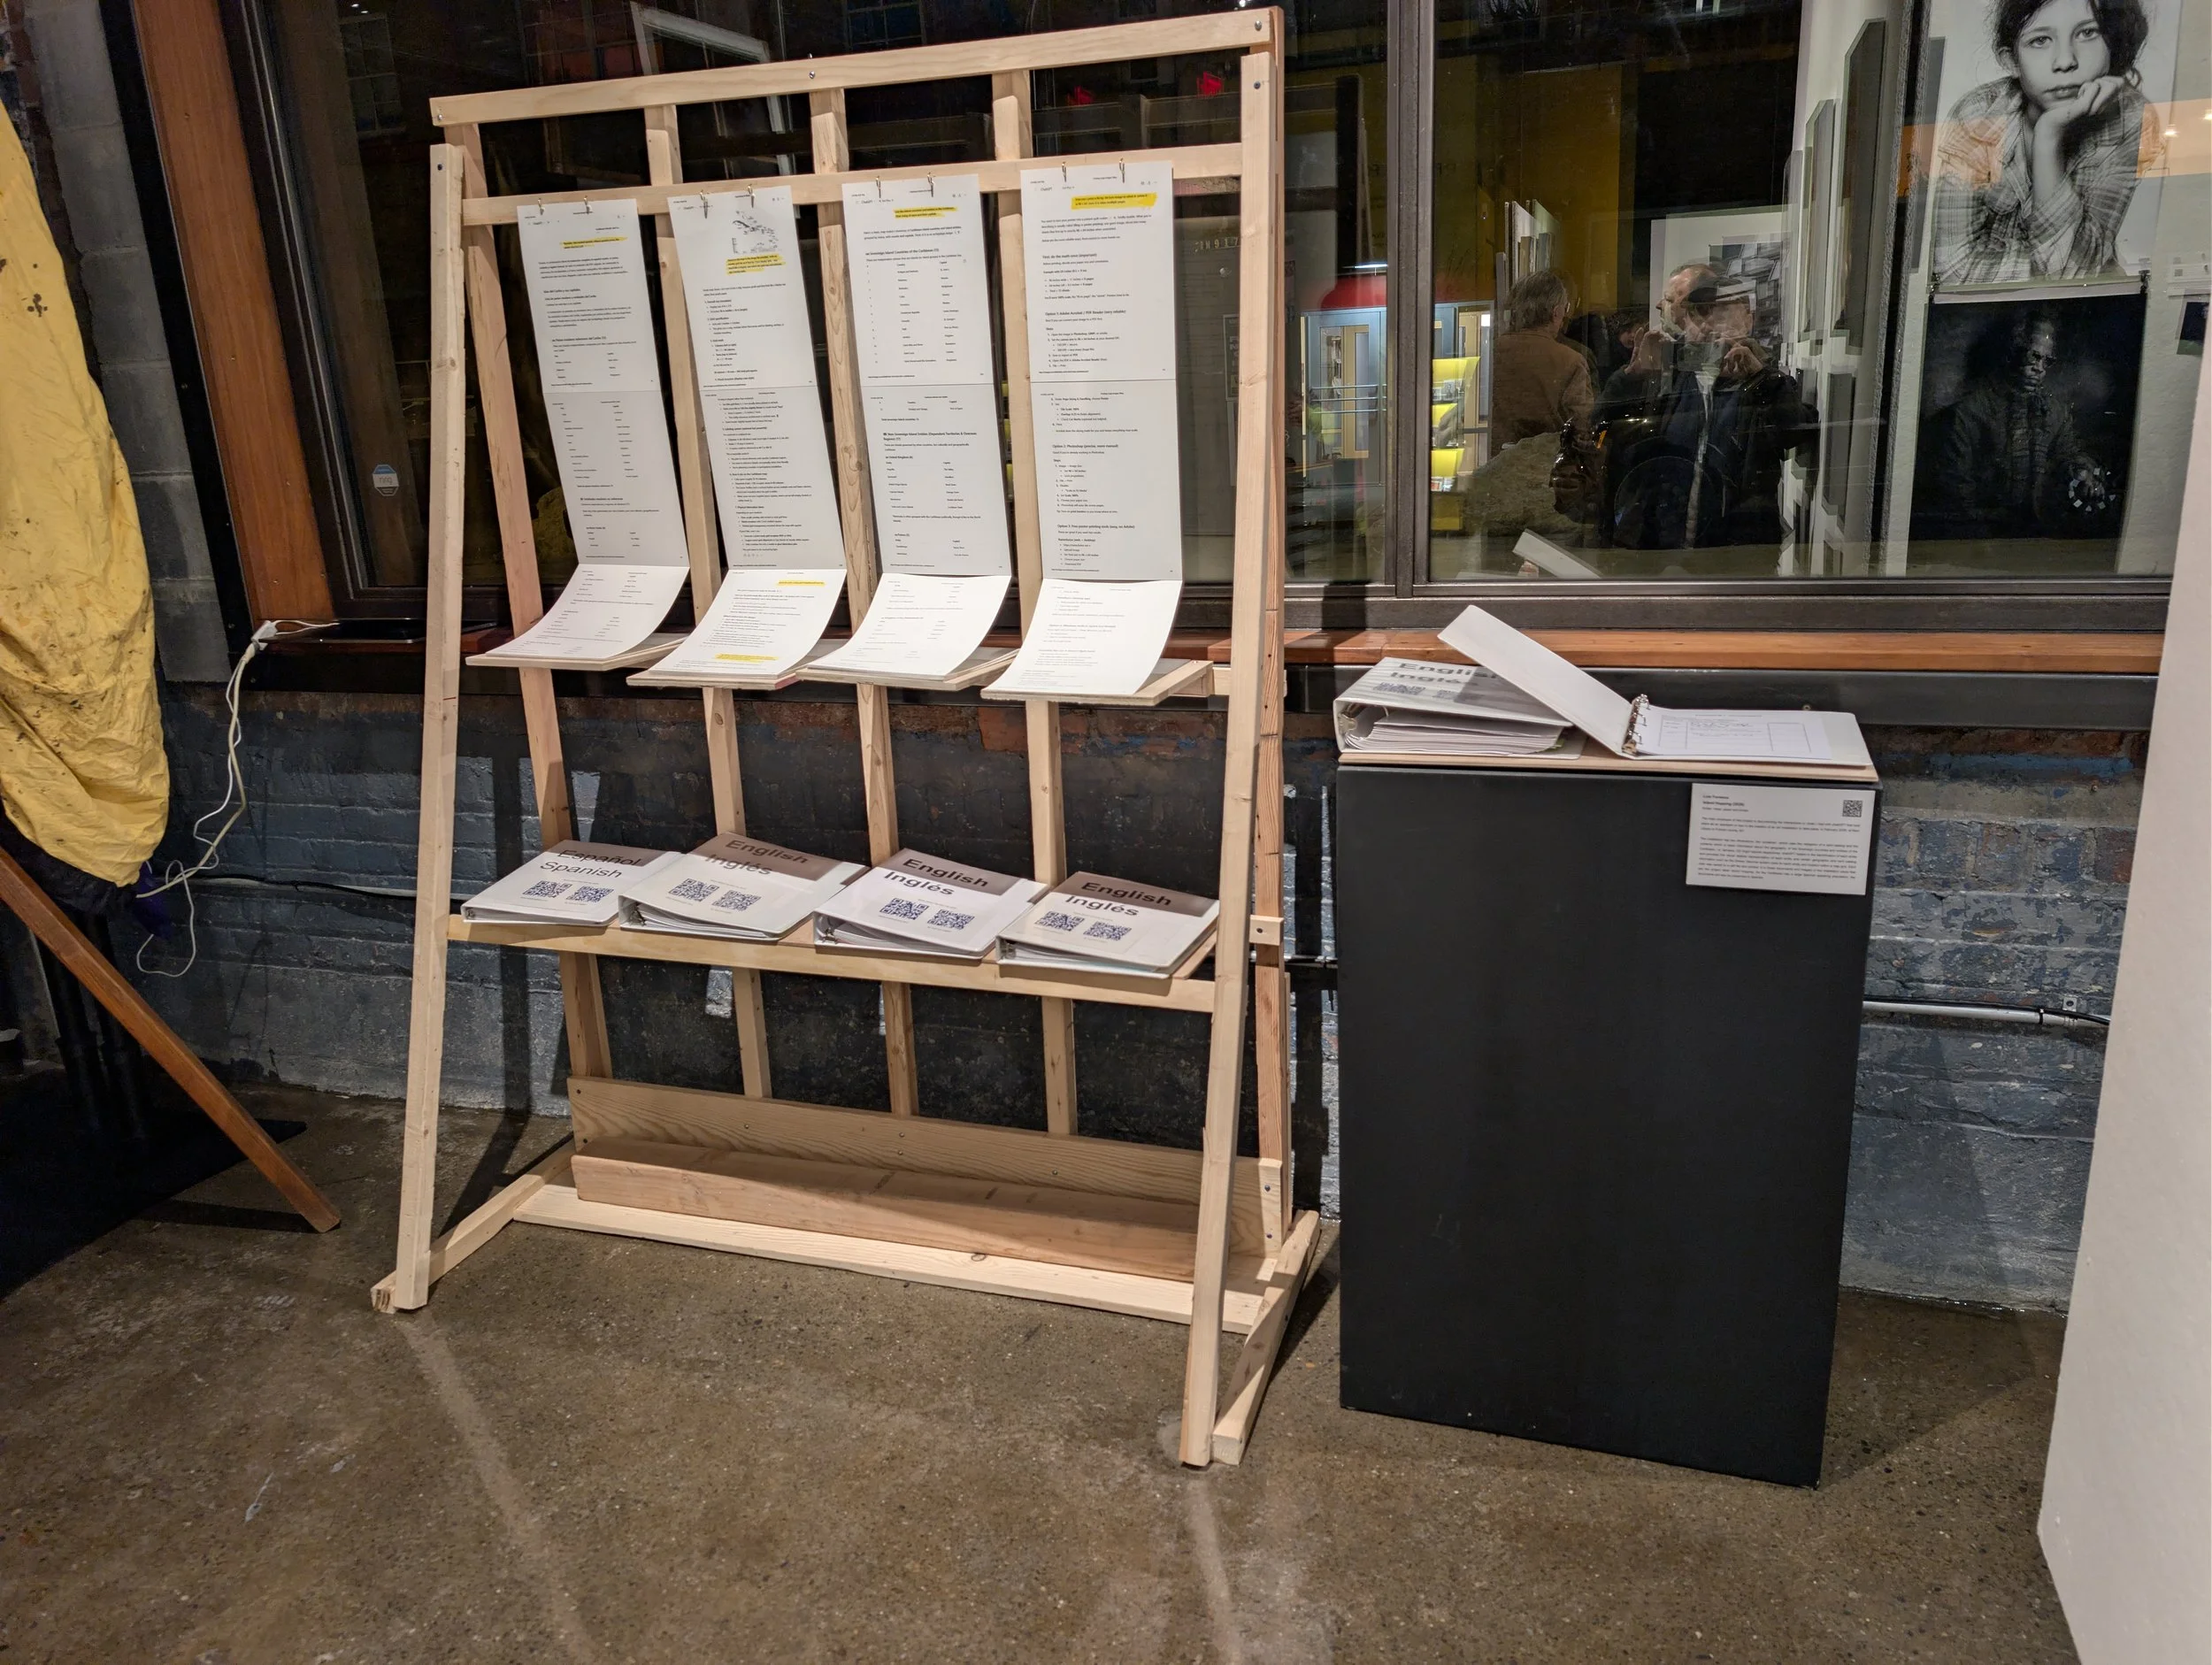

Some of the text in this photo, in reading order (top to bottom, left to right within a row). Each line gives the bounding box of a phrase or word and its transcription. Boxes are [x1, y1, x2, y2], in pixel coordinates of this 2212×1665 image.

[557, 849, 643, 867] Español
[726, 839, 809, 865] English
[540, 860, 623, 879] Spanish
[705, 853, 773, 876] Inglés
[901, 857, 989, 888] English
[883, 871, 955, 895] Inglés
[1081, 881, 1172, 907] English
[1065, 894, 1140, 917] Inglés
